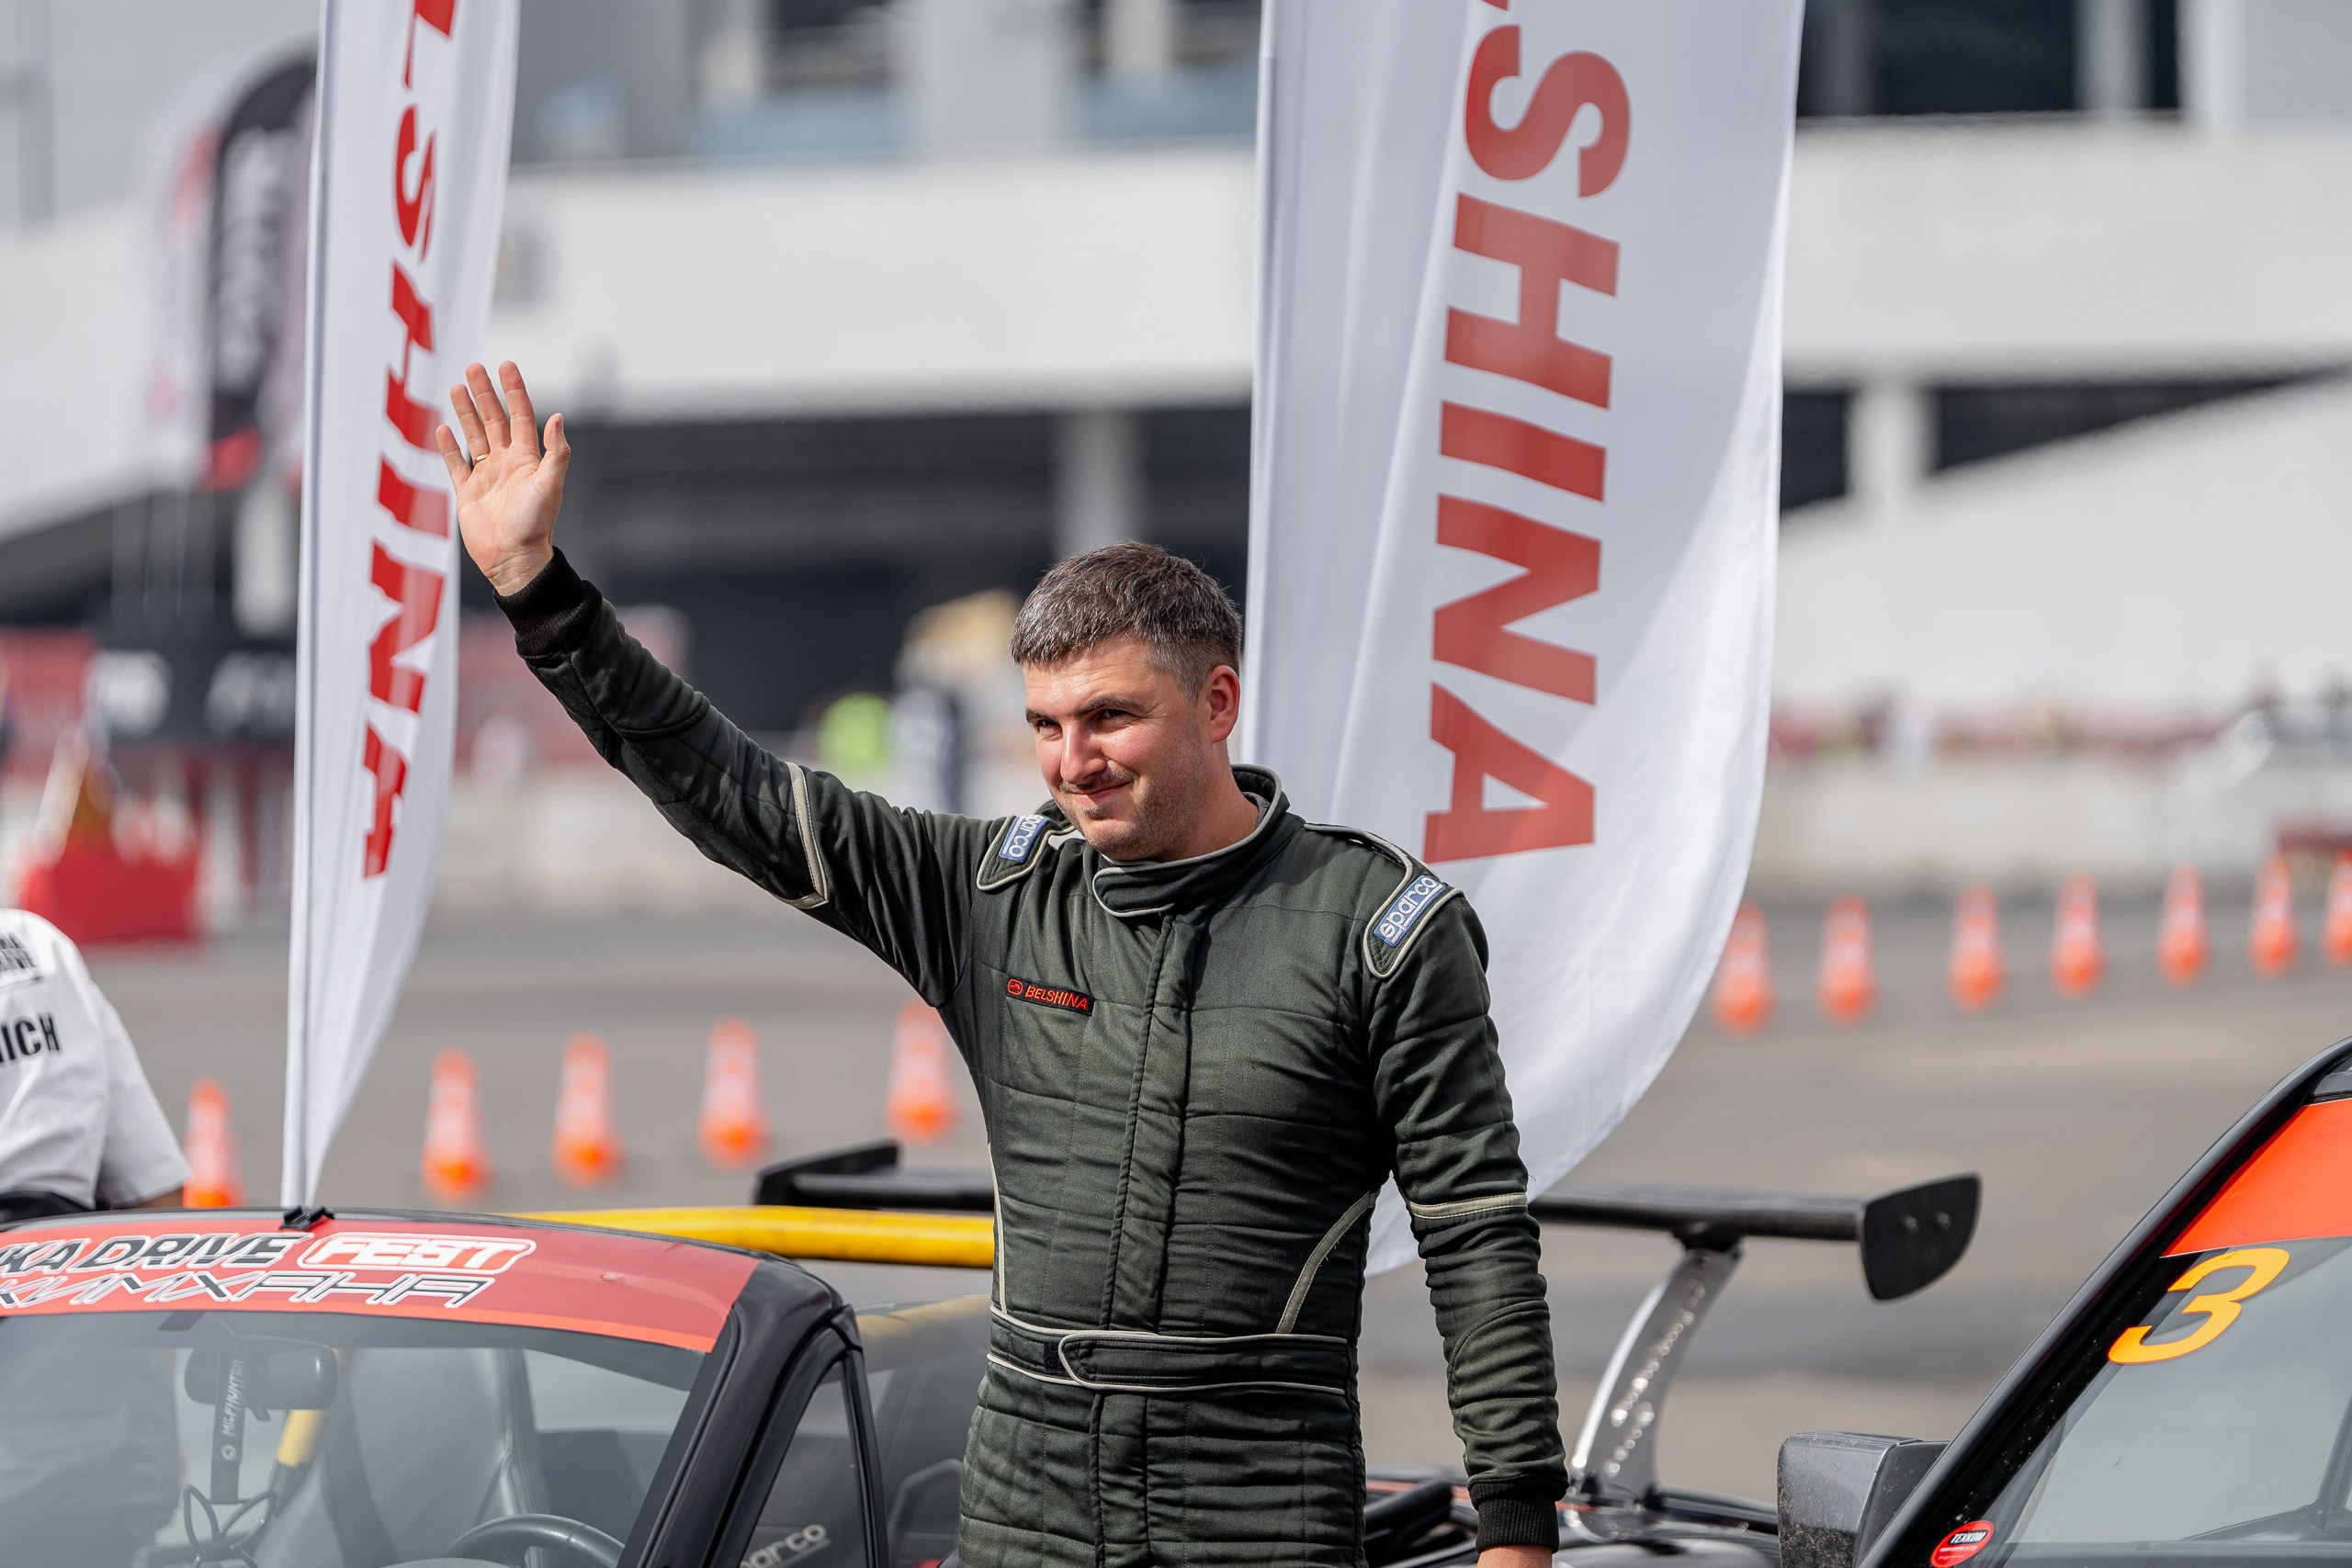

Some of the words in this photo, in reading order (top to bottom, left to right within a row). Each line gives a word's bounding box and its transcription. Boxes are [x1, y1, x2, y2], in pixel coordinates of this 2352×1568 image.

[1423, 0, 1631, 863] SHINA
[1003, 815, 1045, 857] parco
[1380, 877, 1442, 942] sparco
[1025, 985, 1088, 1010] BELSHINA
[0, 1014, 61, 1064] ICH
[66, 1233, 314, 1272] DRIVE
[303, 1237, 530, 1270] FEST
[2109, 1247, 2290, 1364] 3
[741, 1525, 827, 1568] arco
